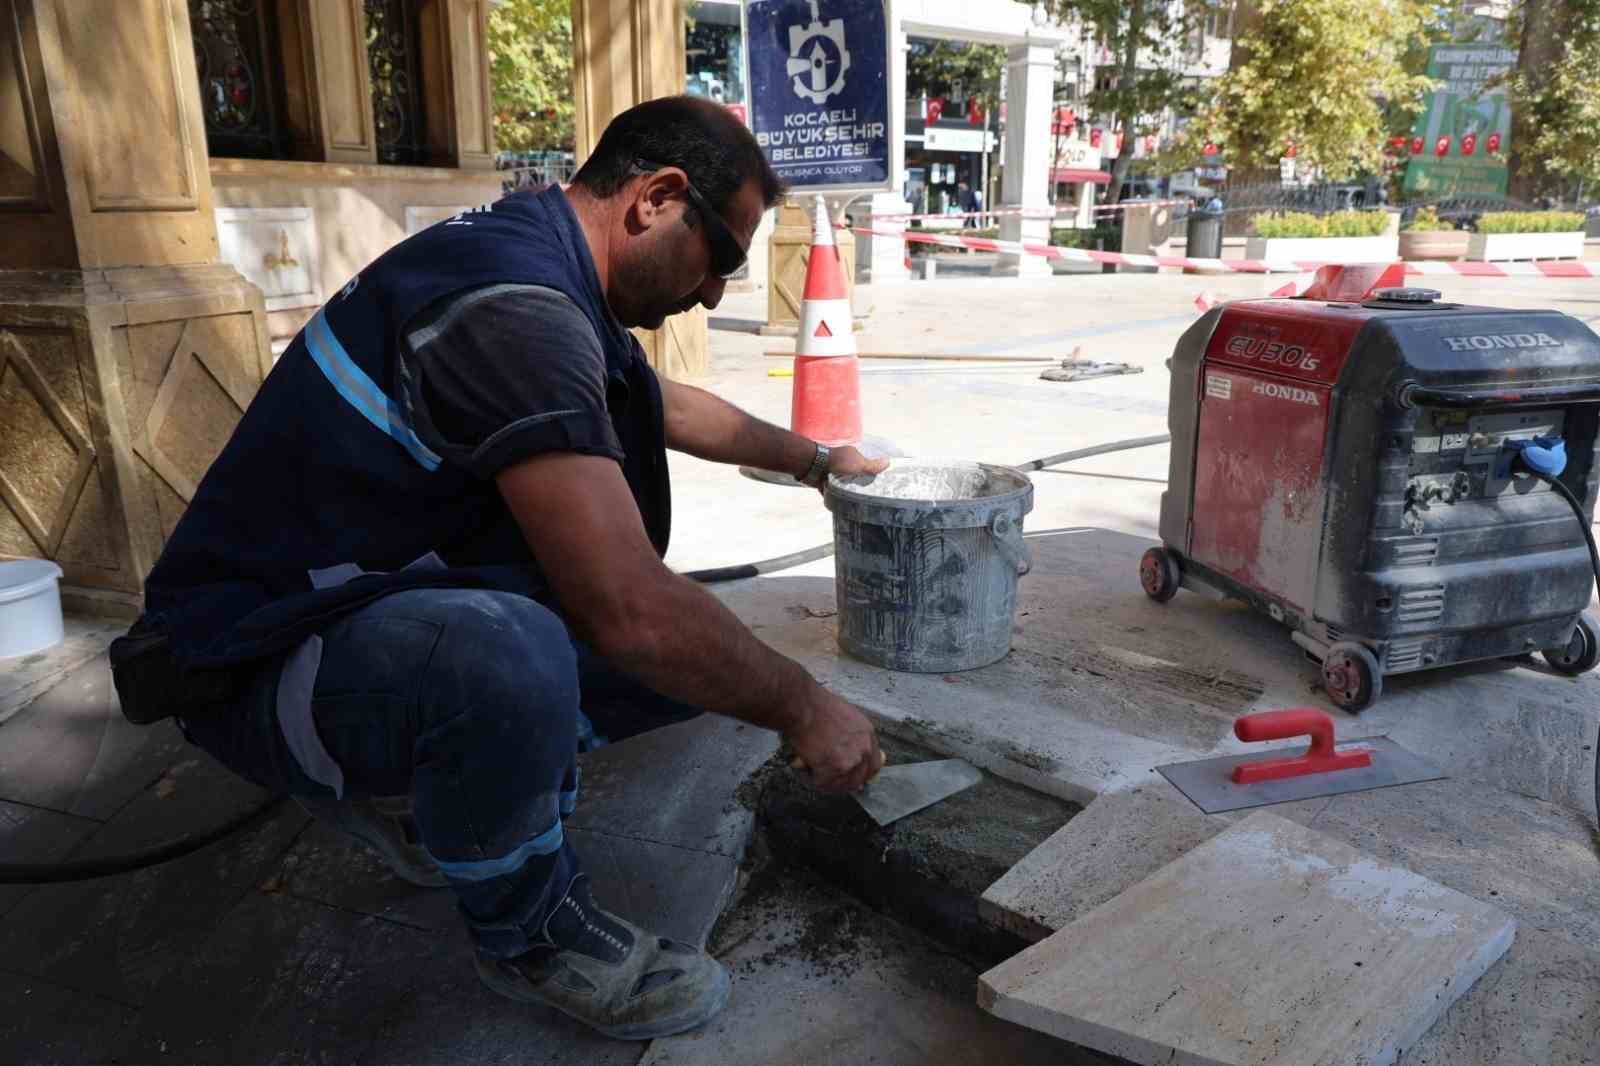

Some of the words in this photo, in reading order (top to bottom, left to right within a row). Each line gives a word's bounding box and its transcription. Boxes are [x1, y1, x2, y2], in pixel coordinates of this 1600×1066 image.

[784, 108, 856, 127] KOCAELİ
[757, 123, 885, 147] BÜYÜKŞEHİR
[772, 142, 868, 161] BELEDİYESİ
[1443, 332, 1561, 351] HONDA
[1250, 381, 1320, 406] HONDA
